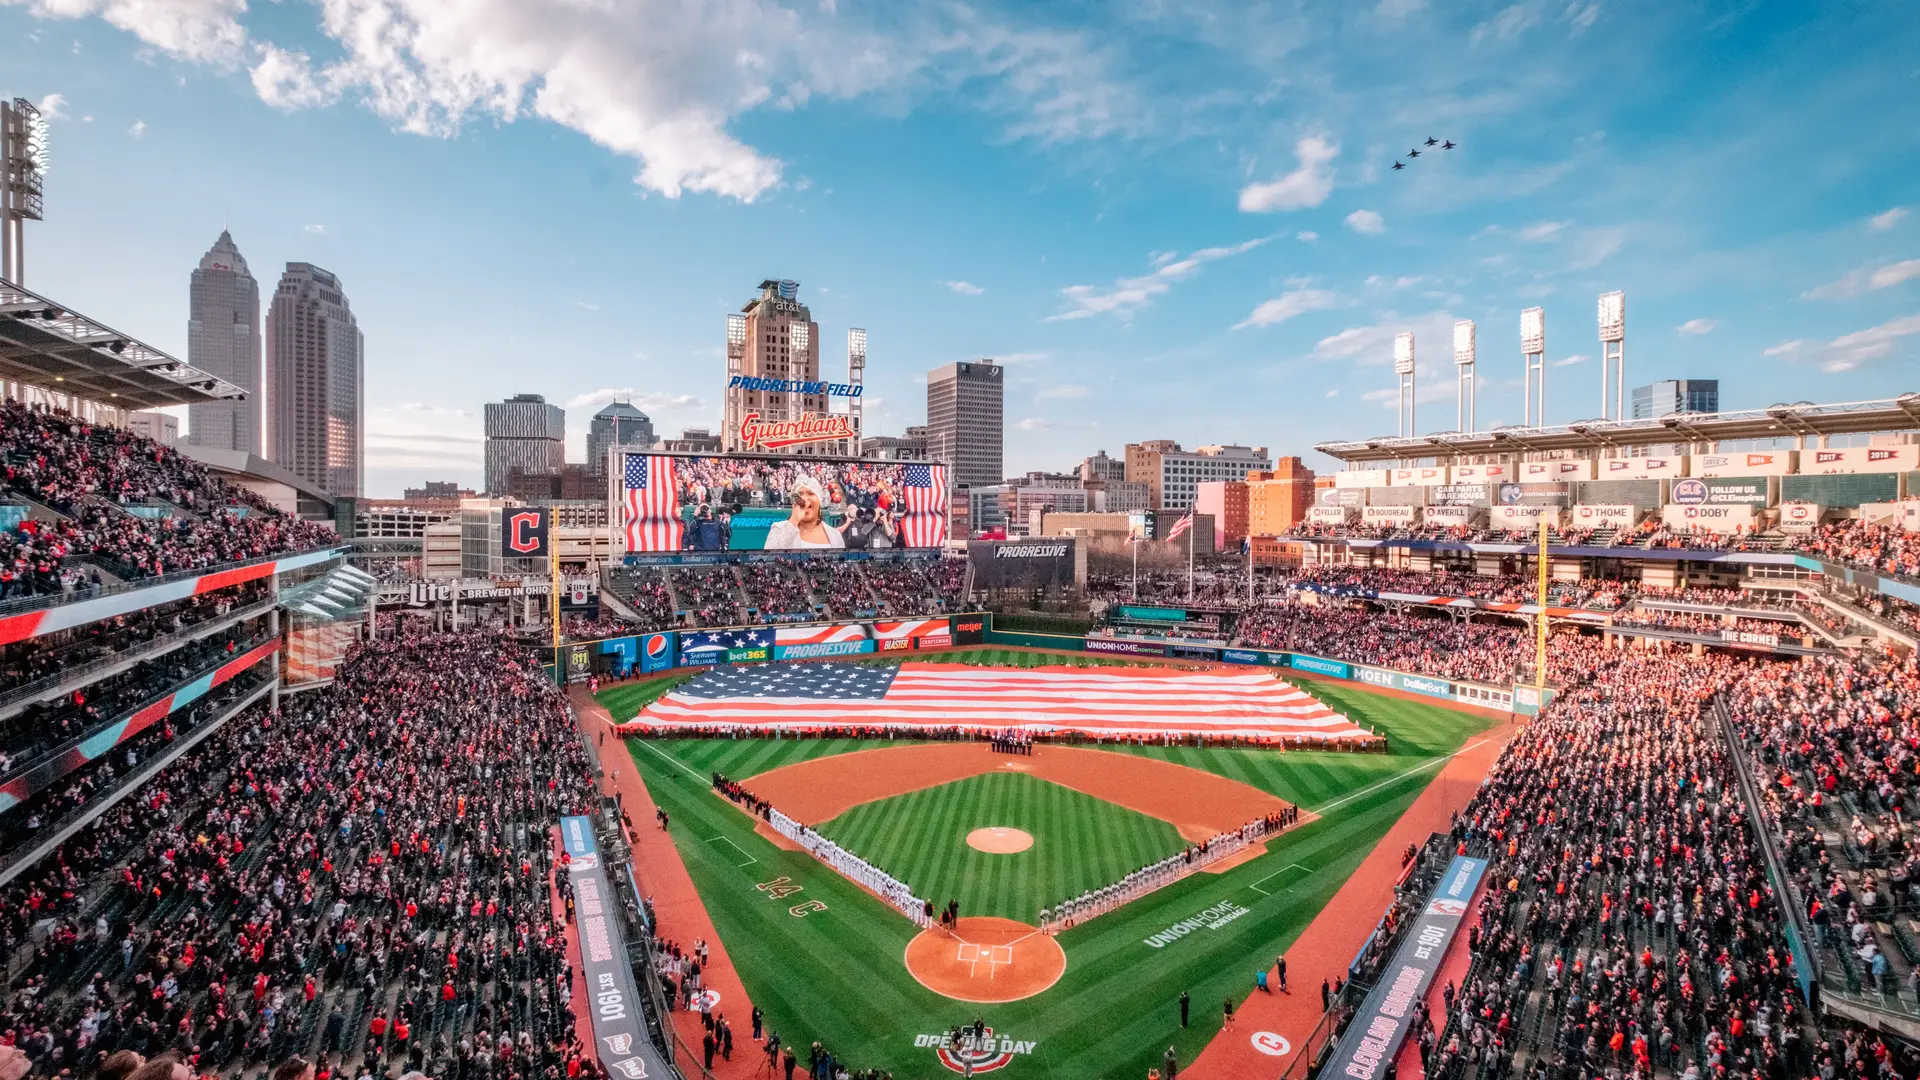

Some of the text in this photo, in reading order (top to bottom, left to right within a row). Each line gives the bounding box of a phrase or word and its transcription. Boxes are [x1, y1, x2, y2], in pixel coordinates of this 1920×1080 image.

[776, 300, 800, 313] at&t
[729, 376, 863, 398] PROGRESSIVE FIELD
[741, 412, 855, 450] Guardians
[1680, 484, 1702, 495] CLE
[1710, 494, 1766, 502] @CLEinspires
[1595, 509, 1627, 517] THOME
[1700, 509, 1729, 517] DOBY
[510, 512, 540, 553] C
[995, 545, 1068, 558] PROGRESSIVE
[408, 582, 450, 607] Lite
[467, 585, 548, 599] BREWED IN OHIO
[957, 622, 982, 633] meijer
[884, 639, 909, 651] BLASTER
[1721, 630, 1778, 647] THE CORNER
[729, 650, 766, 660] bet365
[783, 640, 864, 659] PROGRESSIVE
[1224, 651, 1258, 662] FirstEnergy
[572, 652, 587, 665] 811
[1294, 658, 1344, 674] PROGRESSIVE
[1354, 668, 1392, 685] MOEN
[1403, 677, 1448, 694] DollarBank
[755, 876, 804, 900] 14
[789, 900, 828, 917] C
[1206, 906, 1251, 930] MORTGAGE
[1414, 924, 1447, 960] EST. 1901
[597, 972, 626, 1022] EST. 1901
[1345, 965, 1425, 1080] CLEVELAND GUARDIANS
[614, 1035, 626, 1052] 1920
[1000, 1040, 1036, 1055] DAY
[624, 1060, 641, 1077] 1948
